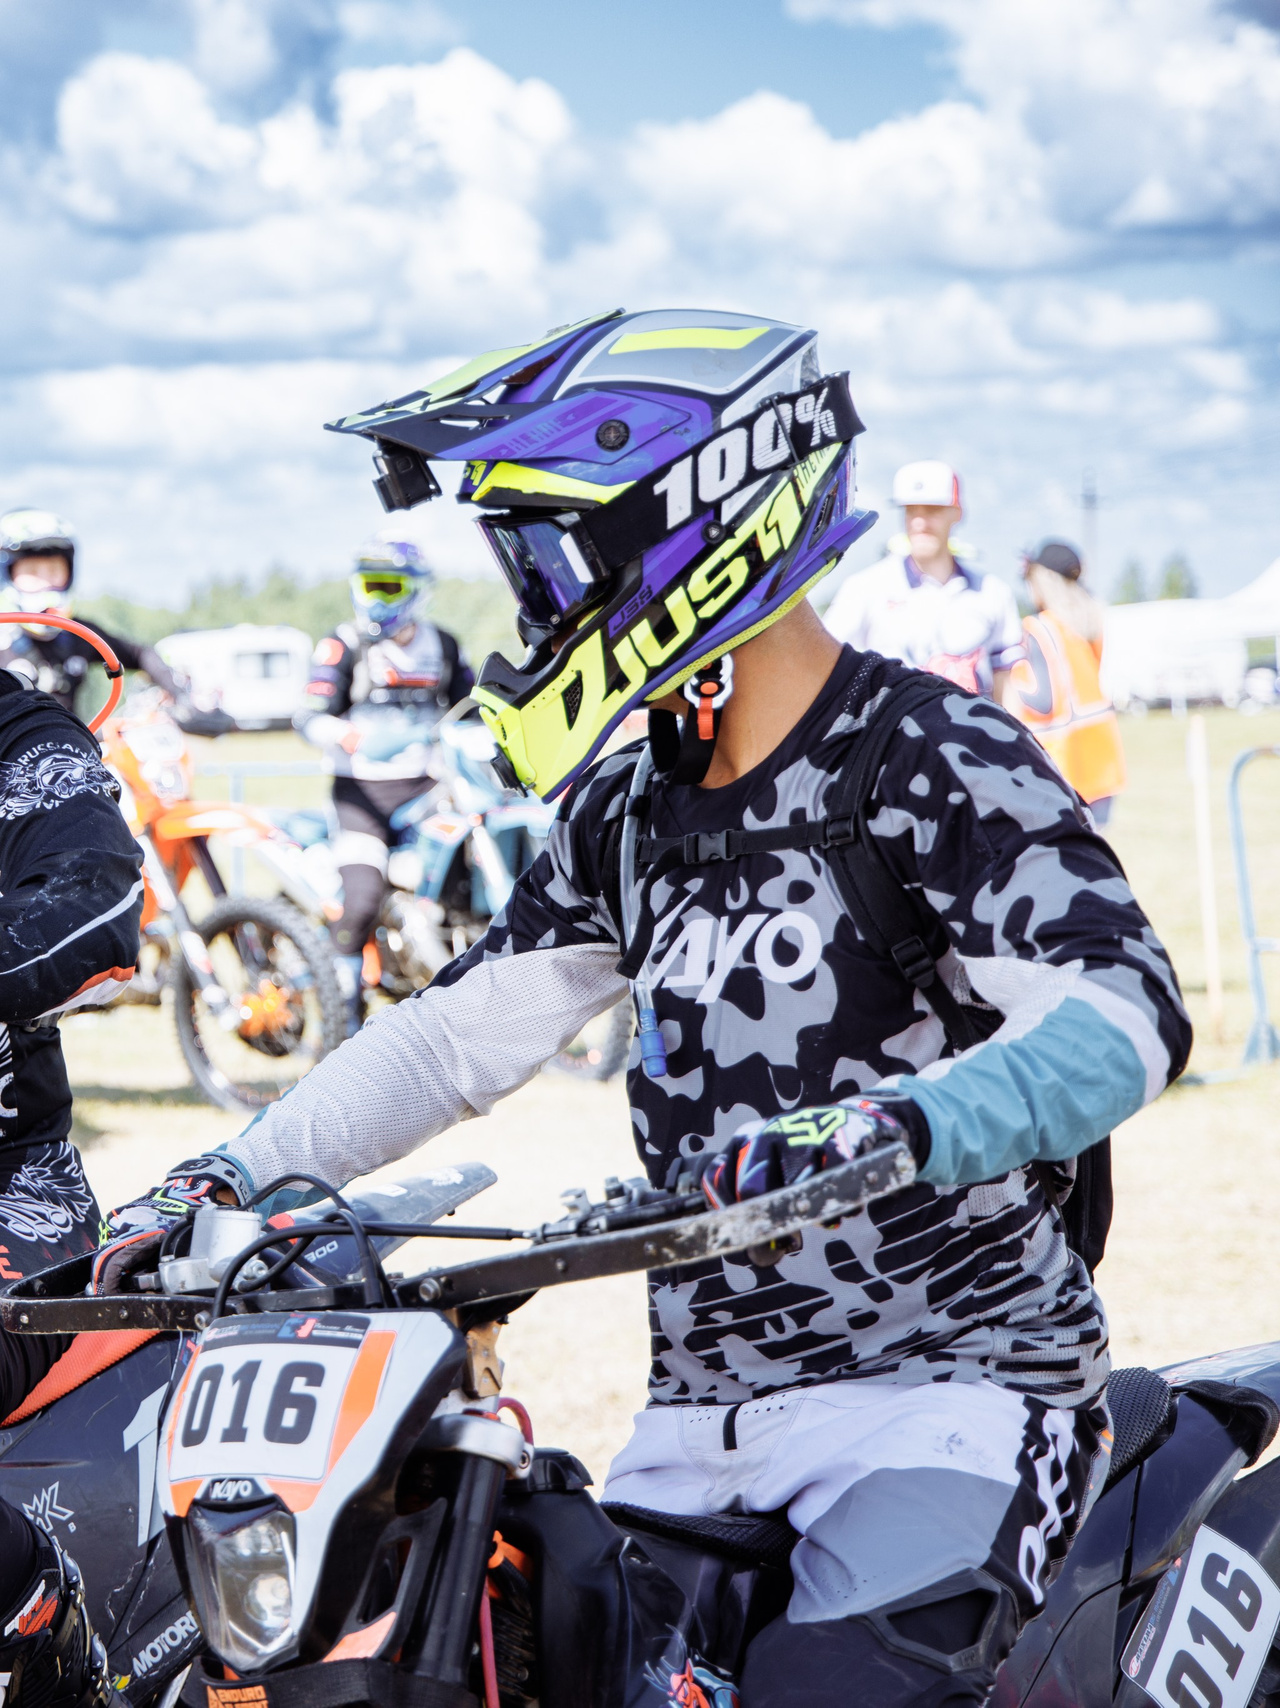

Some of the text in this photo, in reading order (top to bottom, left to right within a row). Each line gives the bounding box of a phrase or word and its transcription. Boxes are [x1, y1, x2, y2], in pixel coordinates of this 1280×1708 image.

[648, 387, 837, 530] 100%
[602, 479, 803, 704] JUST1
[181, 1359, 326, 1448] 016
[211, 1480, 253, 1501] KAYO
[1166, 1552, 1262, 1708] 016
